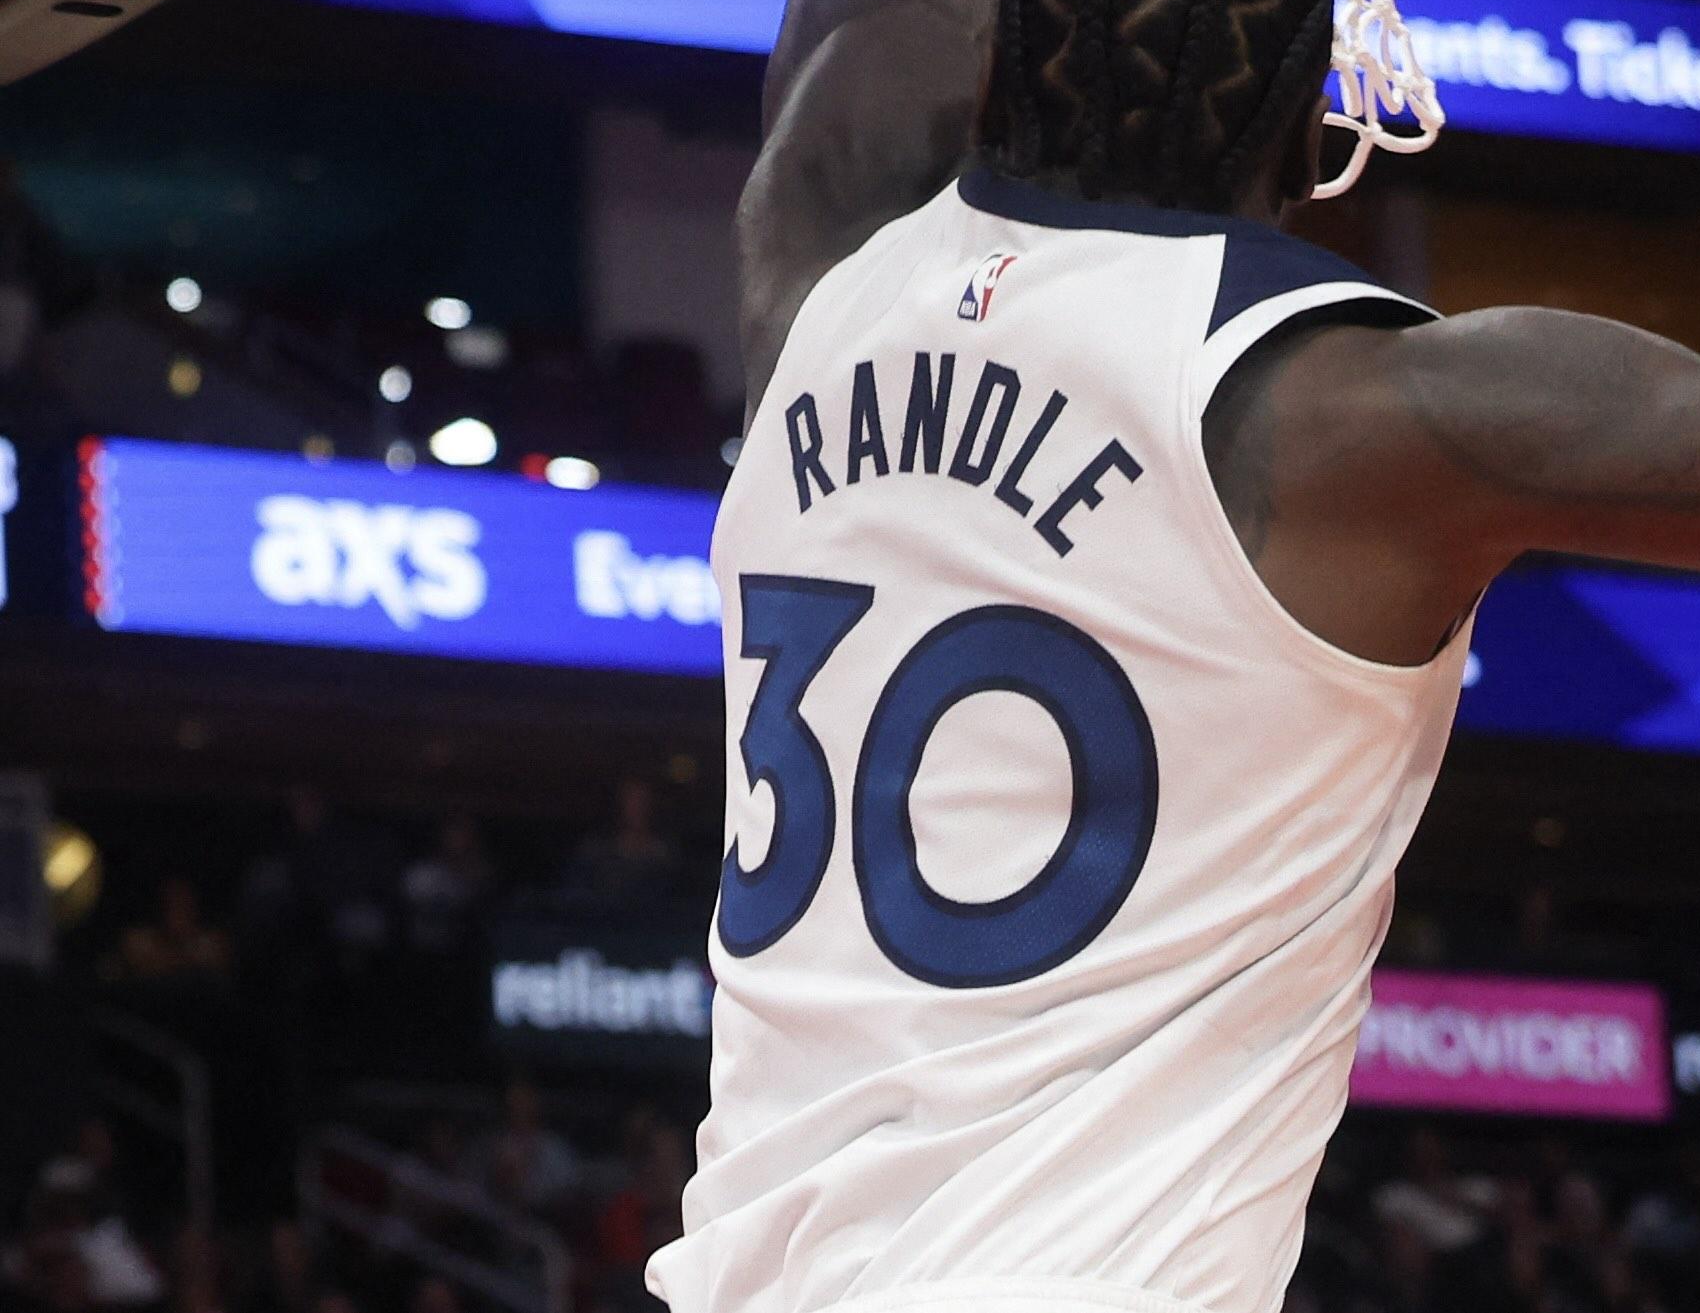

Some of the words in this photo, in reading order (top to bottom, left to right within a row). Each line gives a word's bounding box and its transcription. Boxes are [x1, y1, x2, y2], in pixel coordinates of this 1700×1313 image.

[785, 352, 1144, 558] RANDLE
[250, 494, 488, 626] axs
[716, 572, 1160, 990] 30
[492, 947, 712, 1038] reliant
